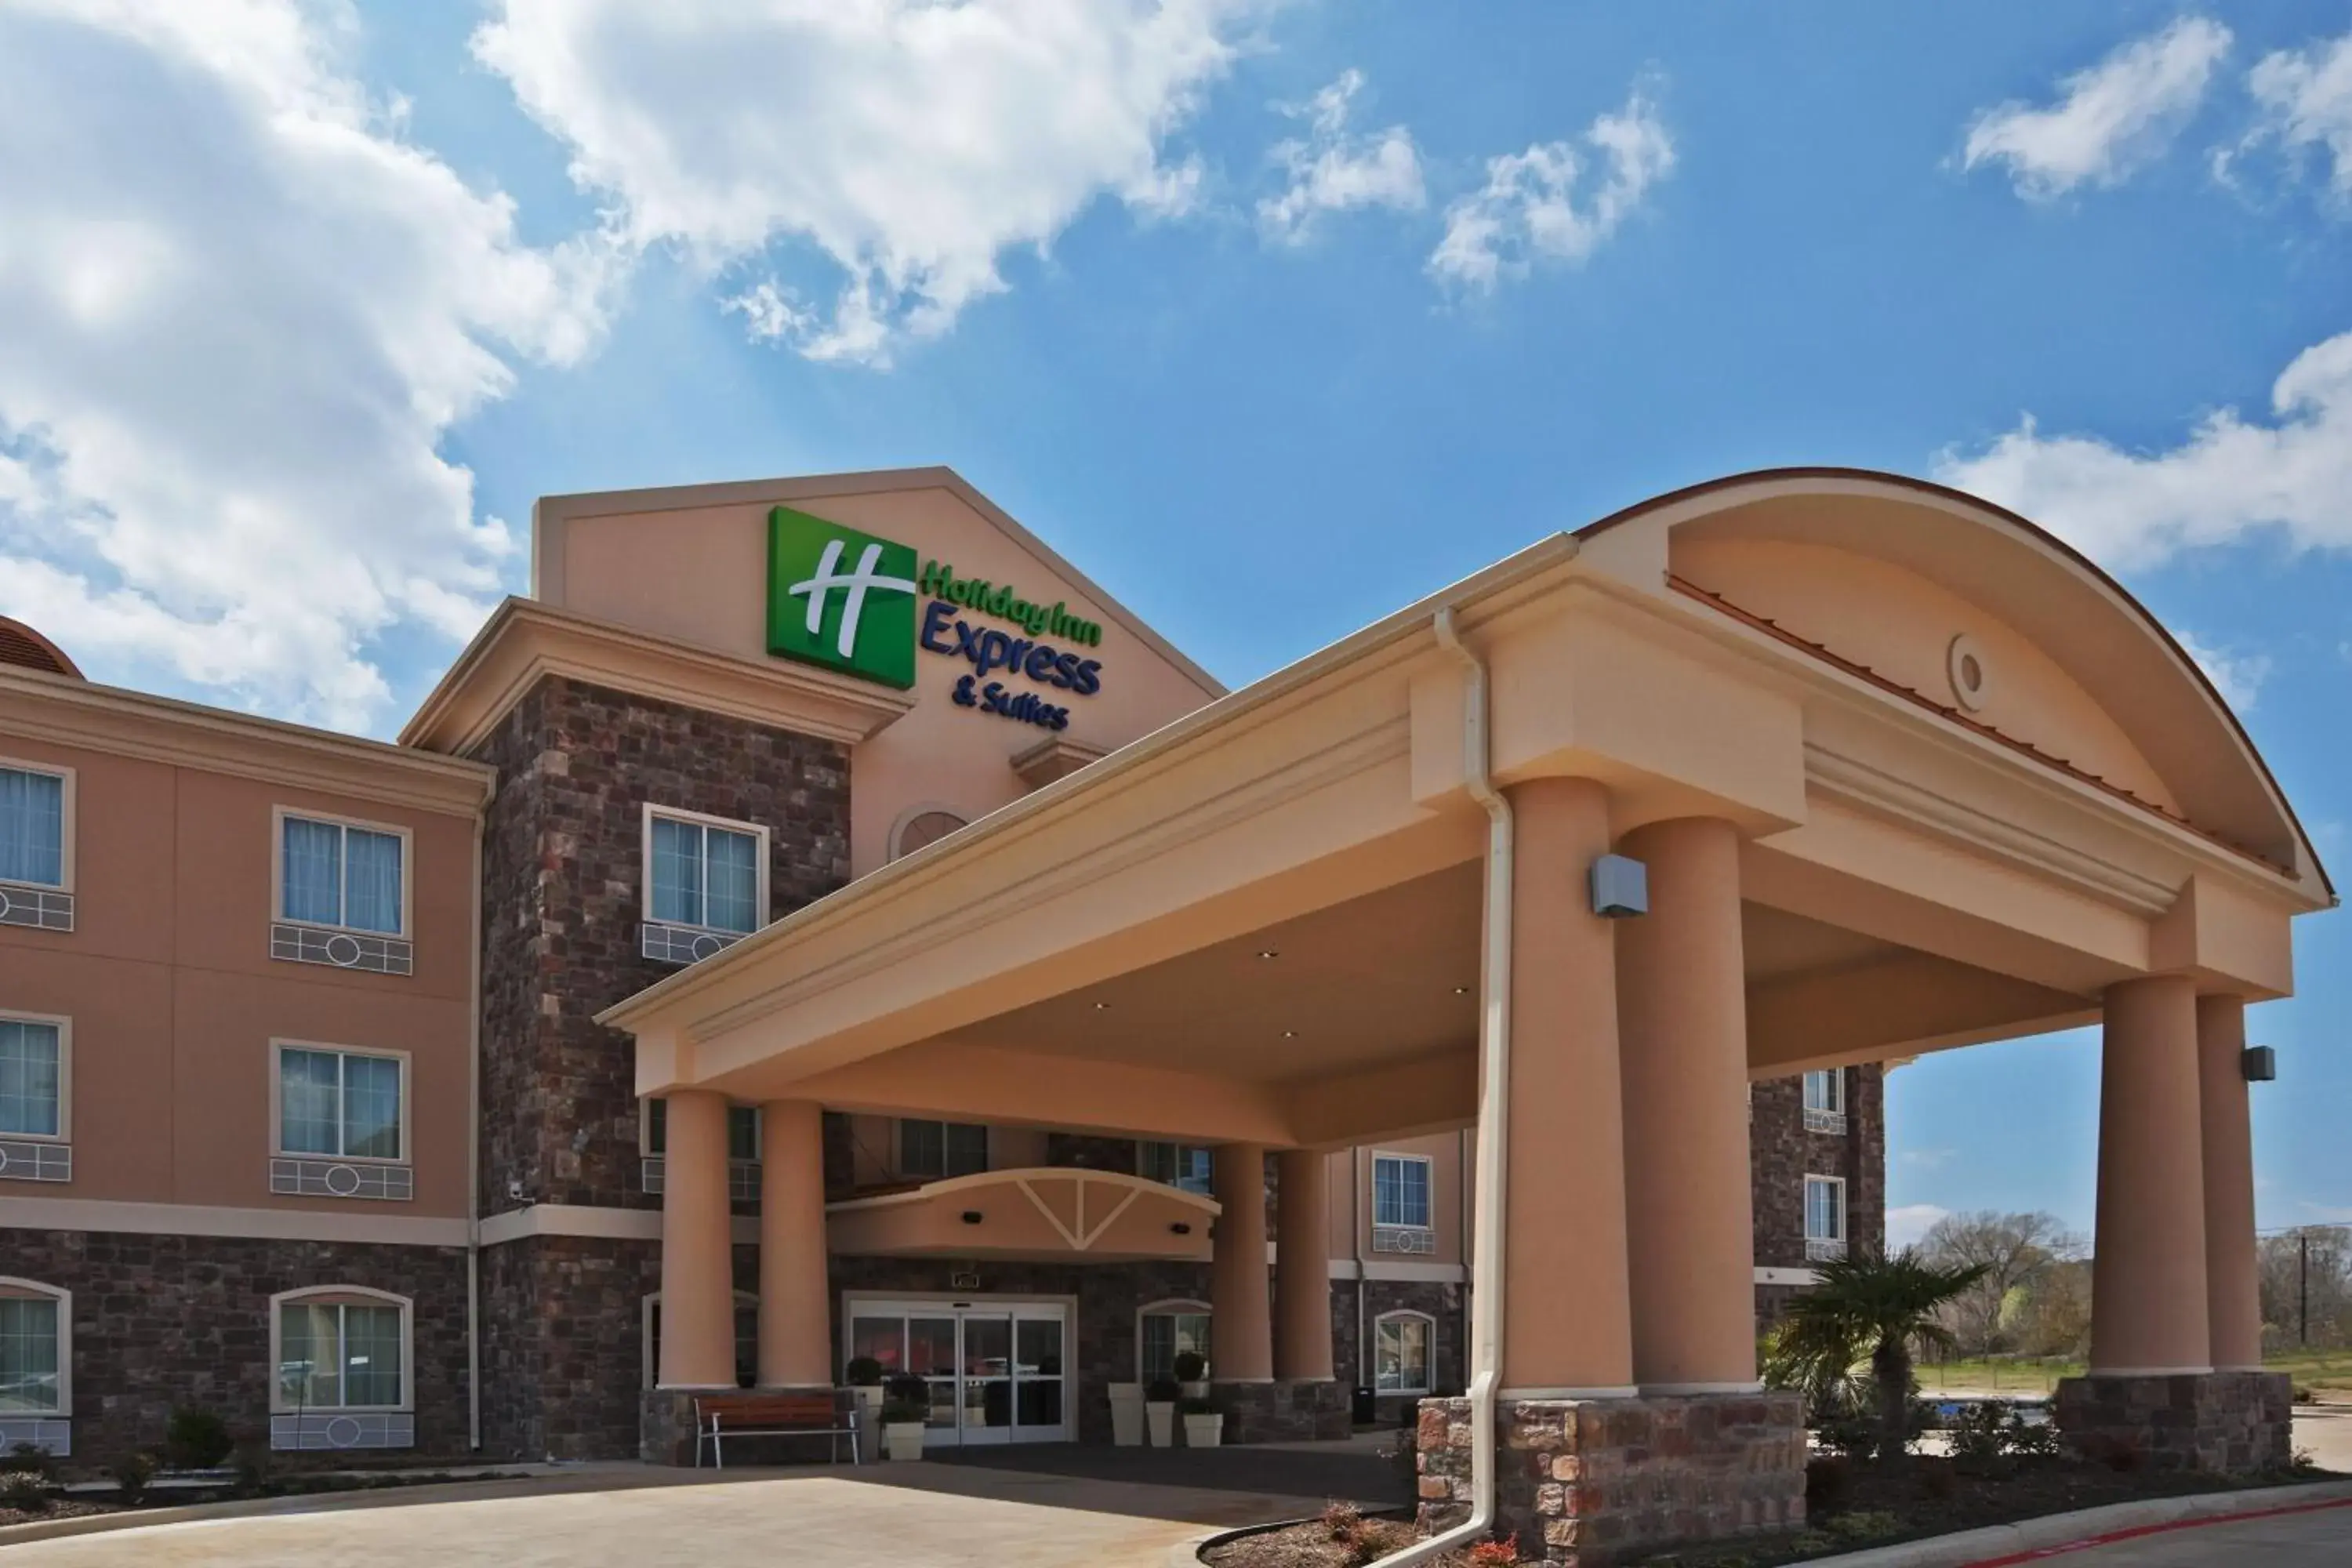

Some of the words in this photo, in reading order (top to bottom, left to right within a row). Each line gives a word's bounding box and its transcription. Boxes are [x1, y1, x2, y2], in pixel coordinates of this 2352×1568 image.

[920, 560, 1051, 637] Holiday
[1051, 601, 1102, 648] Inn
[921, 601, 1102, 695] Express
[952, 675, 978, 707] &
[980, 682, 1069, 731] Suites
